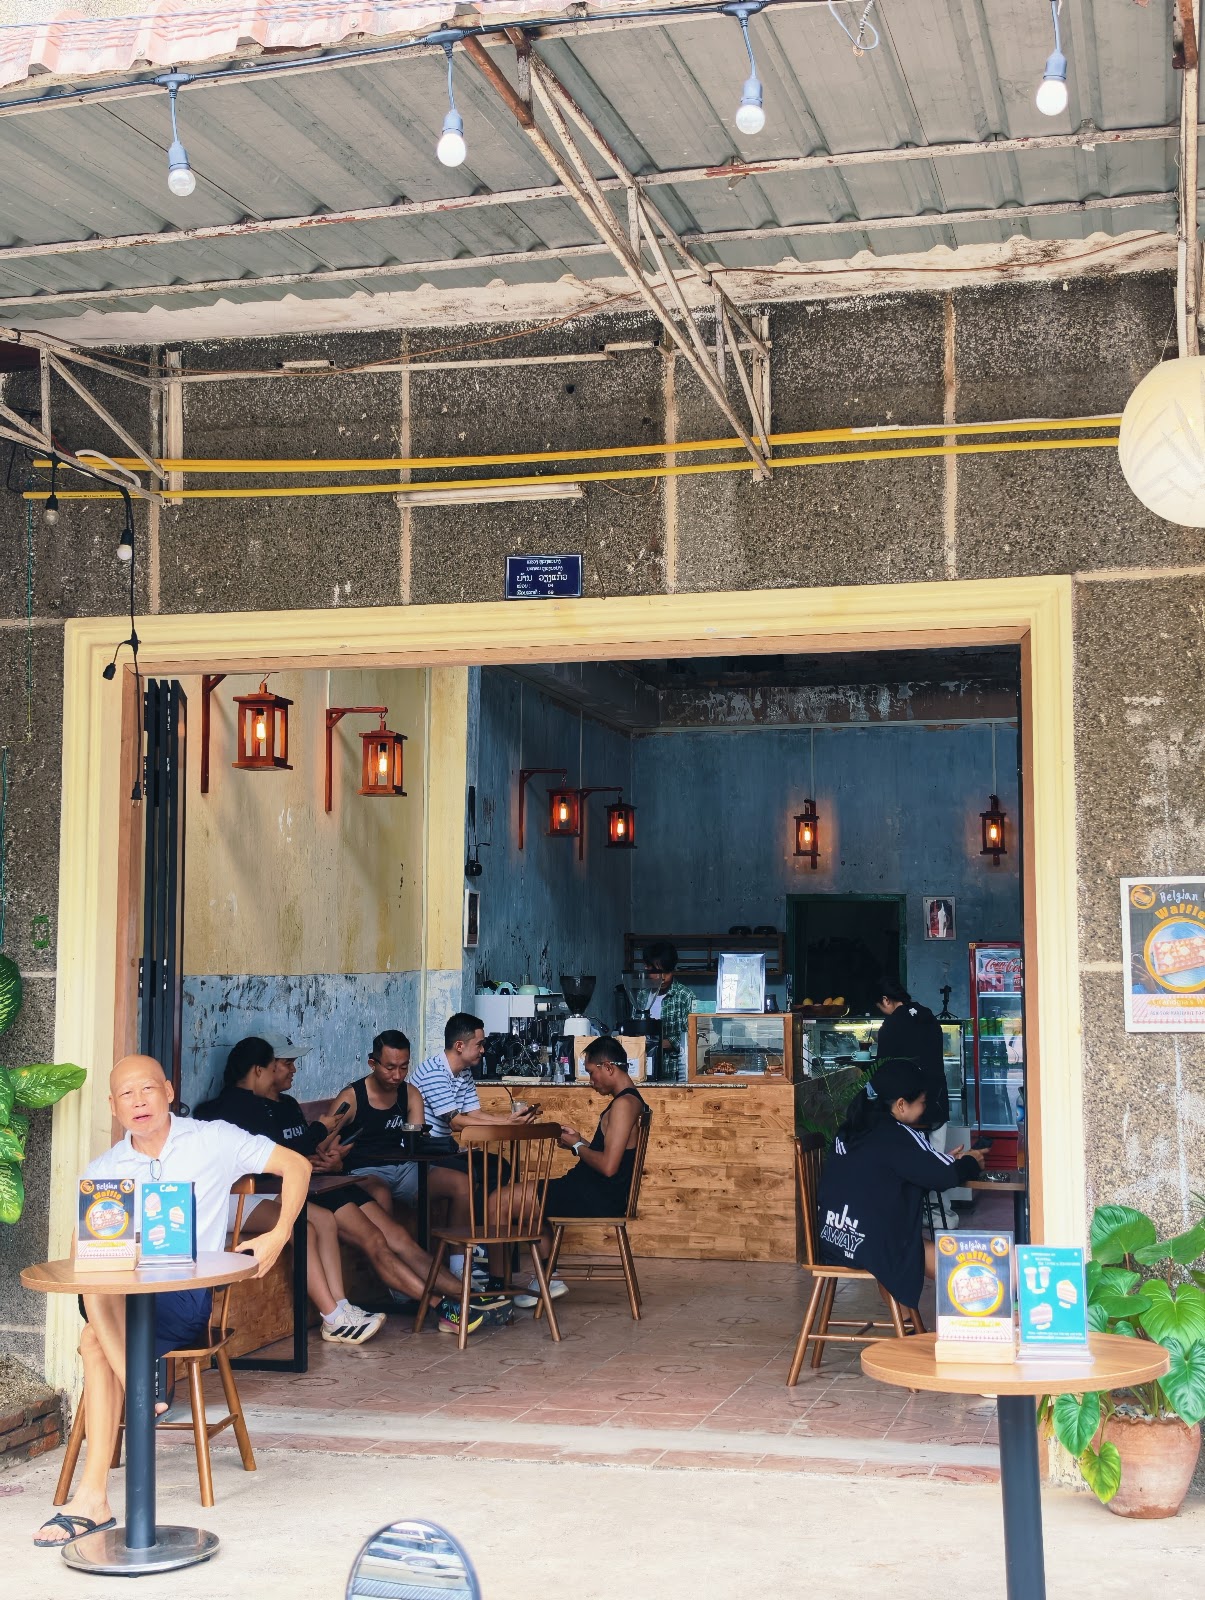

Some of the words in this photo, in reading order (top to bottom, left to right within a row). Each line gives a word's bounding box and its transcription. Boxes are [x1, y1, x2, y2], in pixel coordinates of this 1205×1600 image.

[1160, 889, 1198, 903] Belgian
[96, 1182, 118, 1191] Belgian
[93, 1189, 122, 1200] Waffle
[826, 1204, 859, 1229] RUN
[820, 1225, 864, 1252] AWAY
[959, 1240, 987, 1252] Belgian
[955, 1250, 993, 1264] Waffle
